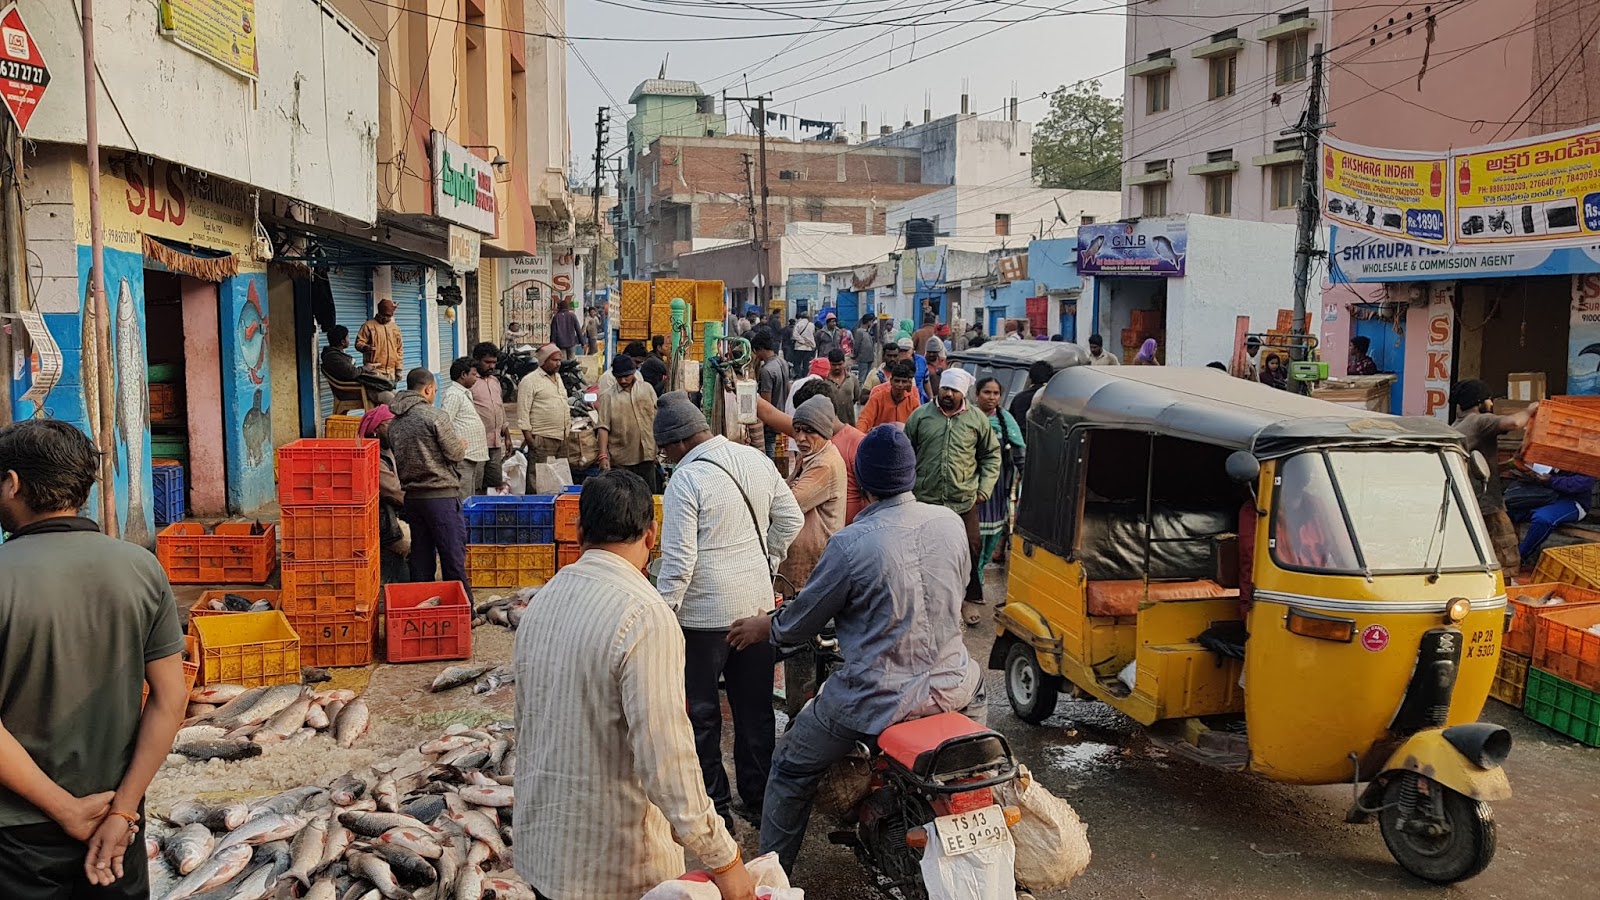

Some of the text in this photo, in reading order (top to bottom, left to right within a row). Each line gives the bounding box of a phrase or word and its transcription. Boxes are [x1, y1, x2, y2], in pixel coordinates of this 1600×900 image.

[0, 60, 43, 84] 6 27 27 27
[1341, 156, 1382, 177] AKSHARA
[124, 157, 186, 227] SLS
[1112, 235, 1146, 247] G.N.B
[1343, 244, 1365, 262] SRI
[1368, 242, 1413, 260] KRUPA
[514, 257, 543, 266] VASAVI
[1362, 254, 1515, 273] WHOLESALE & COMMISSION AGENT
[403, 620, 453, 637] AMP
[1371, 631, 1380, 640] 4
[1471, 630, 1494, 644] AP 28
[1476, 644, 1496, 657] 5303
[952, 812, 987, 832] TS 13
[946, 835, 965, 851] EE
